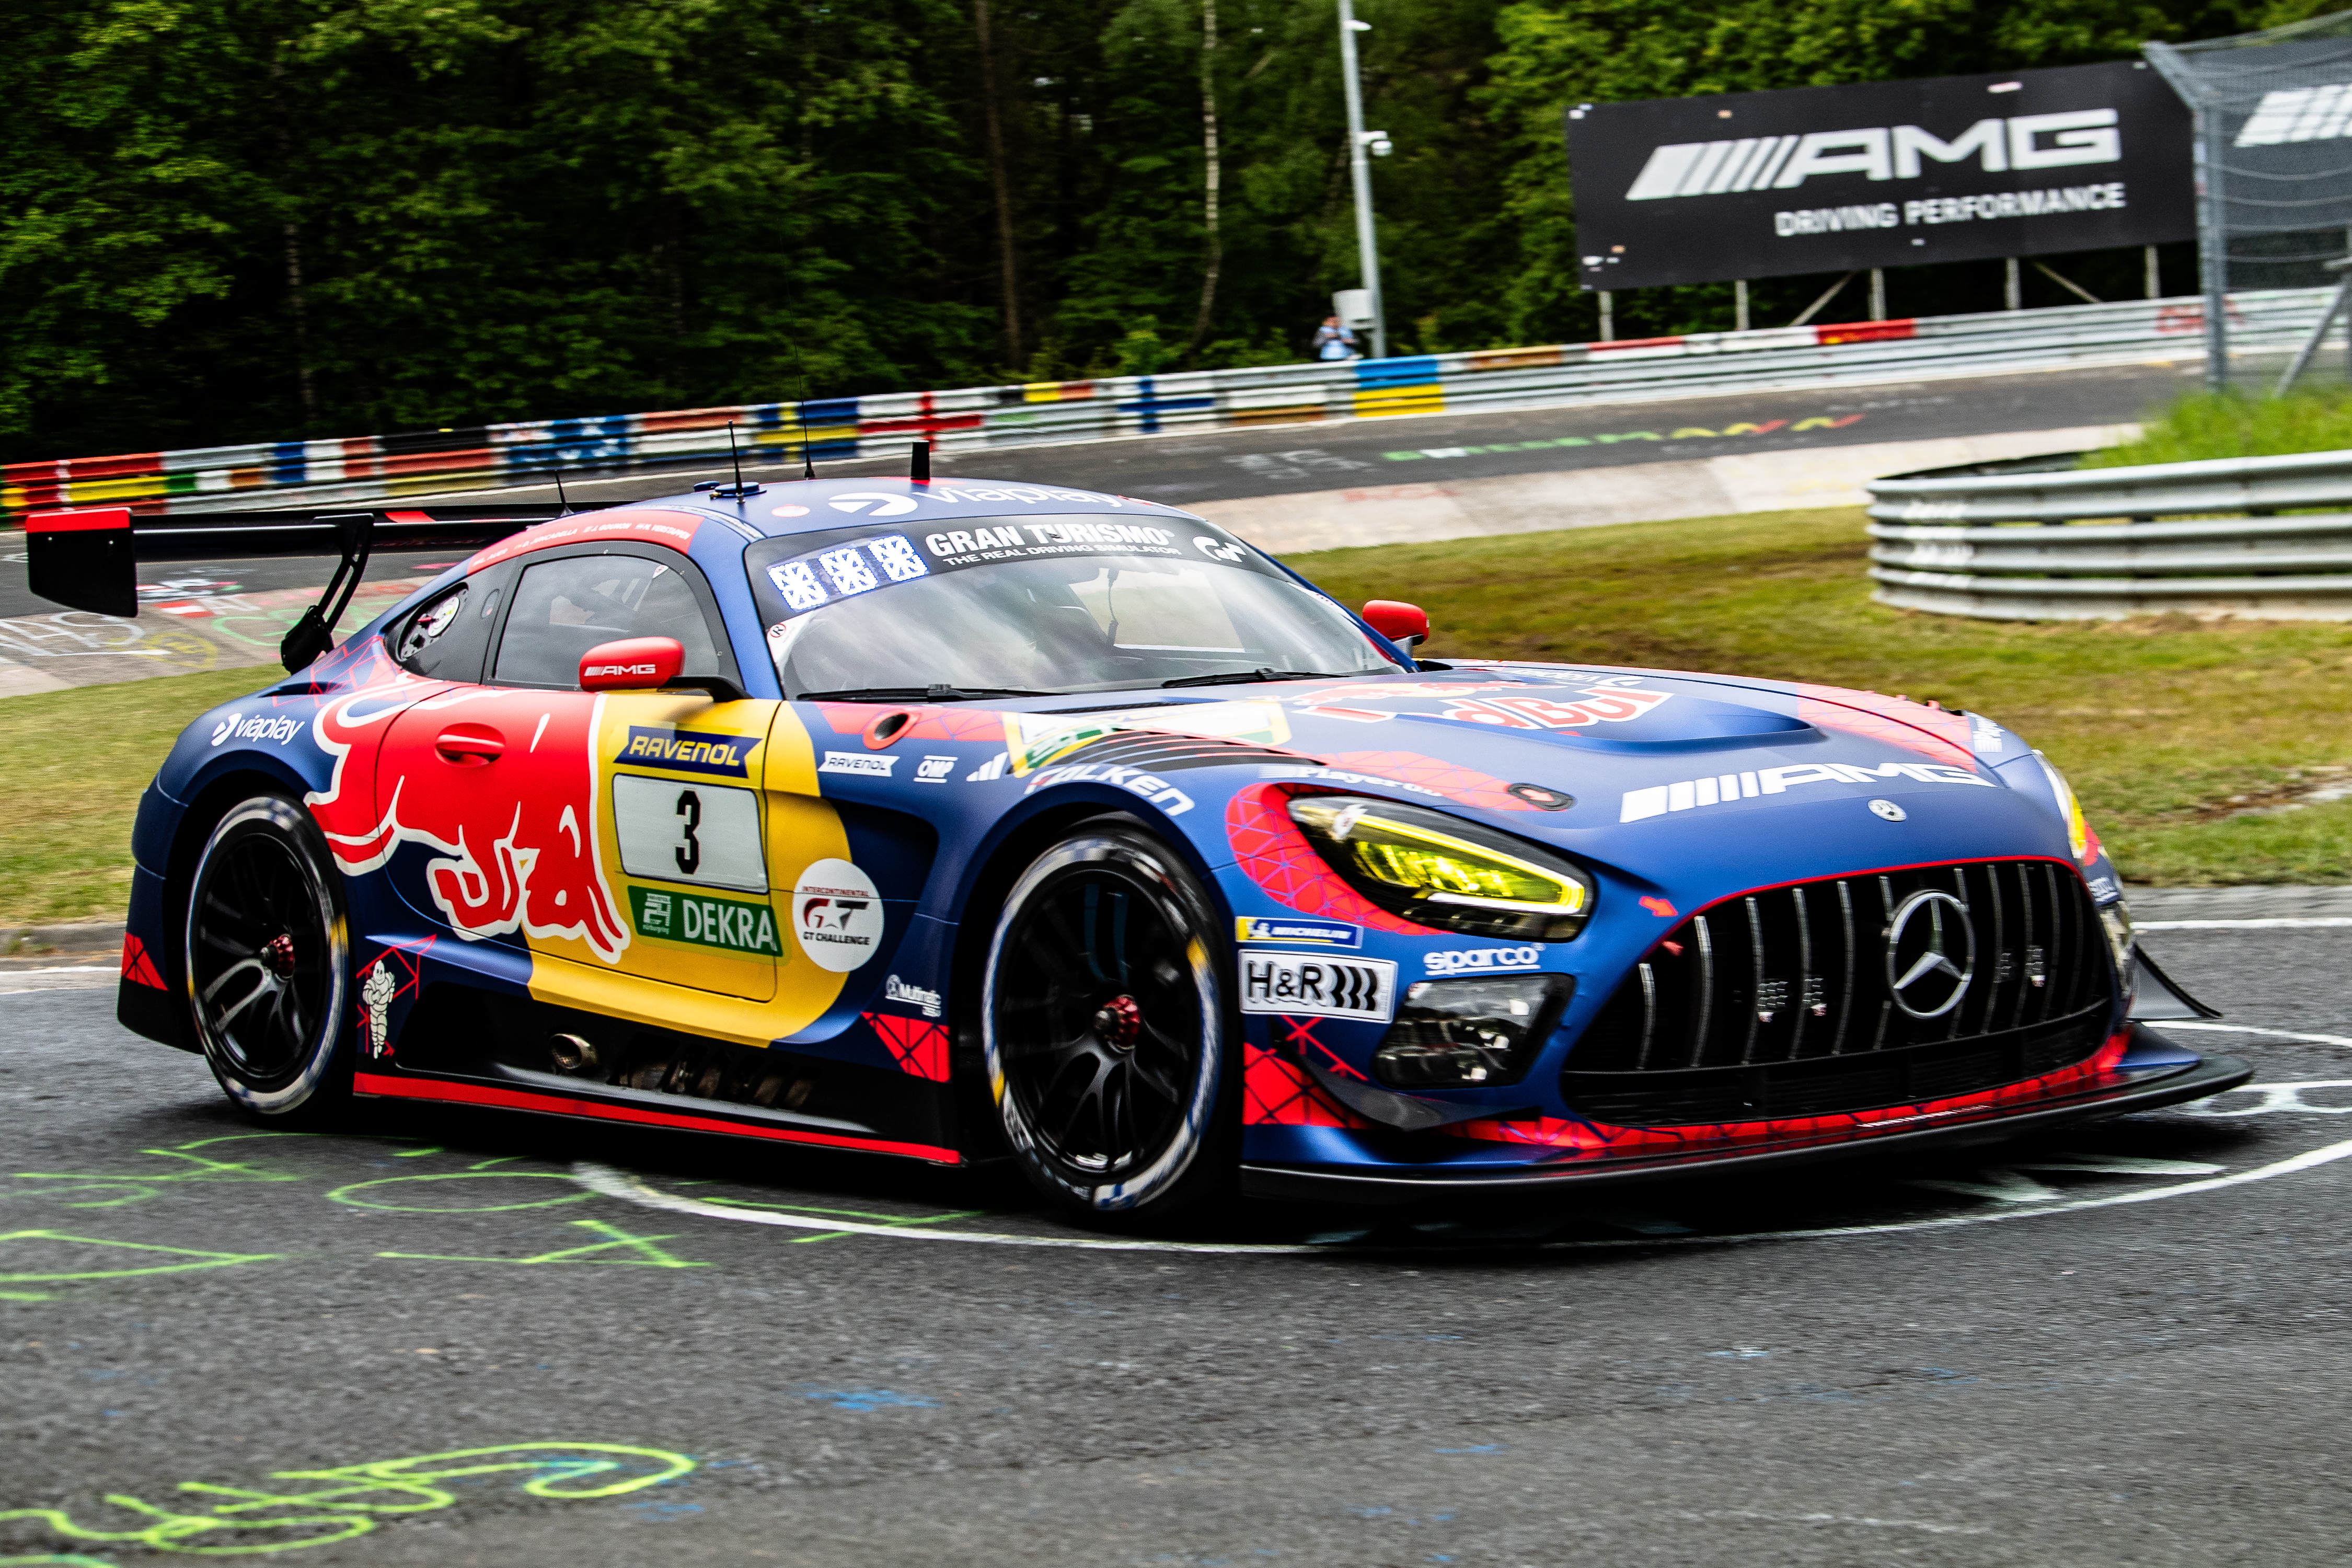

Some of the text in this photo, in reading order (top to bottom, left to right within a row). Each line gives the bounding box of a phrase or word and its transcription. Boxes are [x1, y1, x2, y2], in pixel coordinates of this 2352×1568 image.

[1773, 108, 2122, 188] AMG
[1774, 183, 2127, 236] DRIVING PERFORMANCE
[913, 486, 1123, 508] viaplay
[926, 525, 1025, 557] GRAN
[943, 544, 1182, 566] THE REAL DRIVING SIMULATOR
[601, 664, 656, 676] AMG
[235, 714, 305, 745] viaplay
[629, 735, 742, 766] RAVENOL
[827, 758, 887, 772] RAVENOL
[1024, 765, 1195, 816] FALKEN
[1762, 762, 1995, 794] AMG
[674, 789, 701, 875] 3
[802, 886, 870, 897] INTERCONTINENTAL
[682, 898, 778, 952] DEKRA
[803, 931, 870, 946] GT CHALLENGE
[1271, 926, 1352, 940] MICHELIN
[1423, 947, 1539, 973] sparco
[1246, 961, 1324, 1001] H&R
